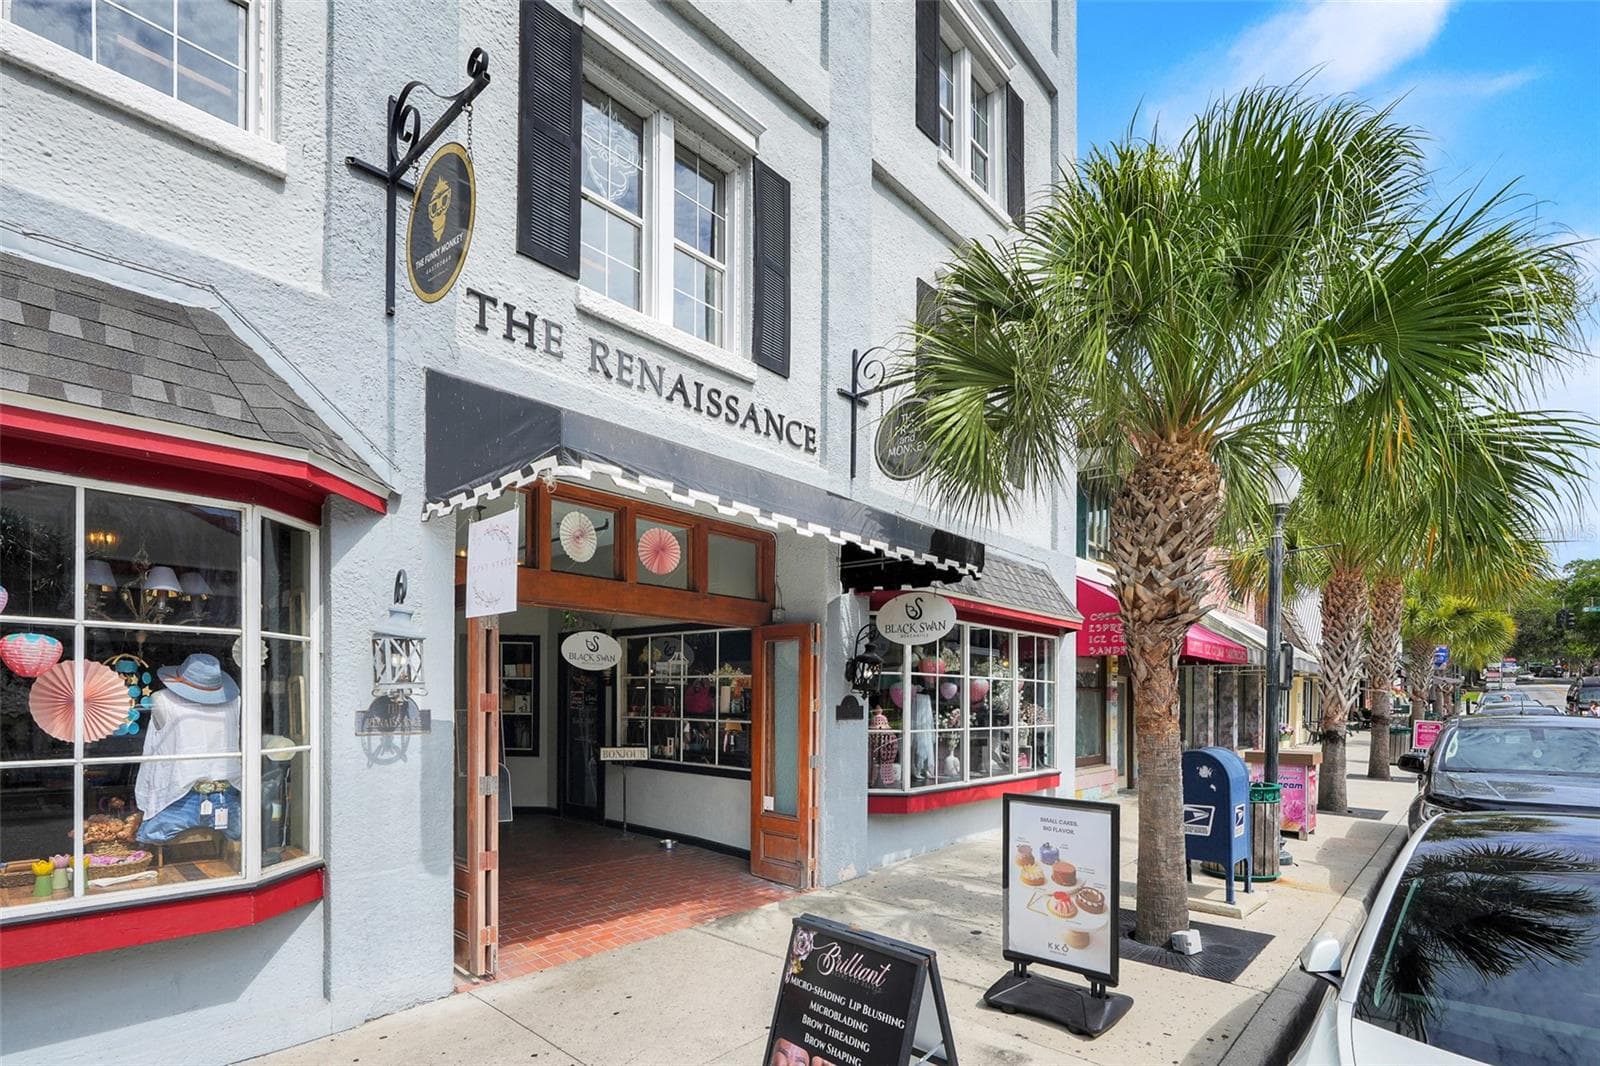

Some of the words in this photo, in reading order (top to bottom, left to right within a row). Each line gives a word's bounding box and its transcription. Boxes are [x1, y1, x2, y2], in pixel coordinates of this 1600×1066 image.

[466, 287, 564, 360] THE
[588, 337, 818, 455] RENAISSANCE
[885, 622, 918, 634] BLACK
[919, 619, 947, 632] SWAN
[568, 652, 595, 662] BLACK
[596, 654, 616, 663] SWAN
[602, 750, 647, 759] BONJOUR
[1040, 817, 1057, 825] SMALL
[813, 942, 892, 988] Brilliant
[790, 975, 847, 1006] MICRO-SHADING
[862, 1004, 906, 1030] BLUSHING
[809, 1000, 869, 1034] MICROBLADING
[801, 1013, 824, 1032] BROW
[824, 1023, 871, 1053] THREADING
[803, 1032, 826, 1051] BROW
[826, 1043, 863, 1066] SHAPING
